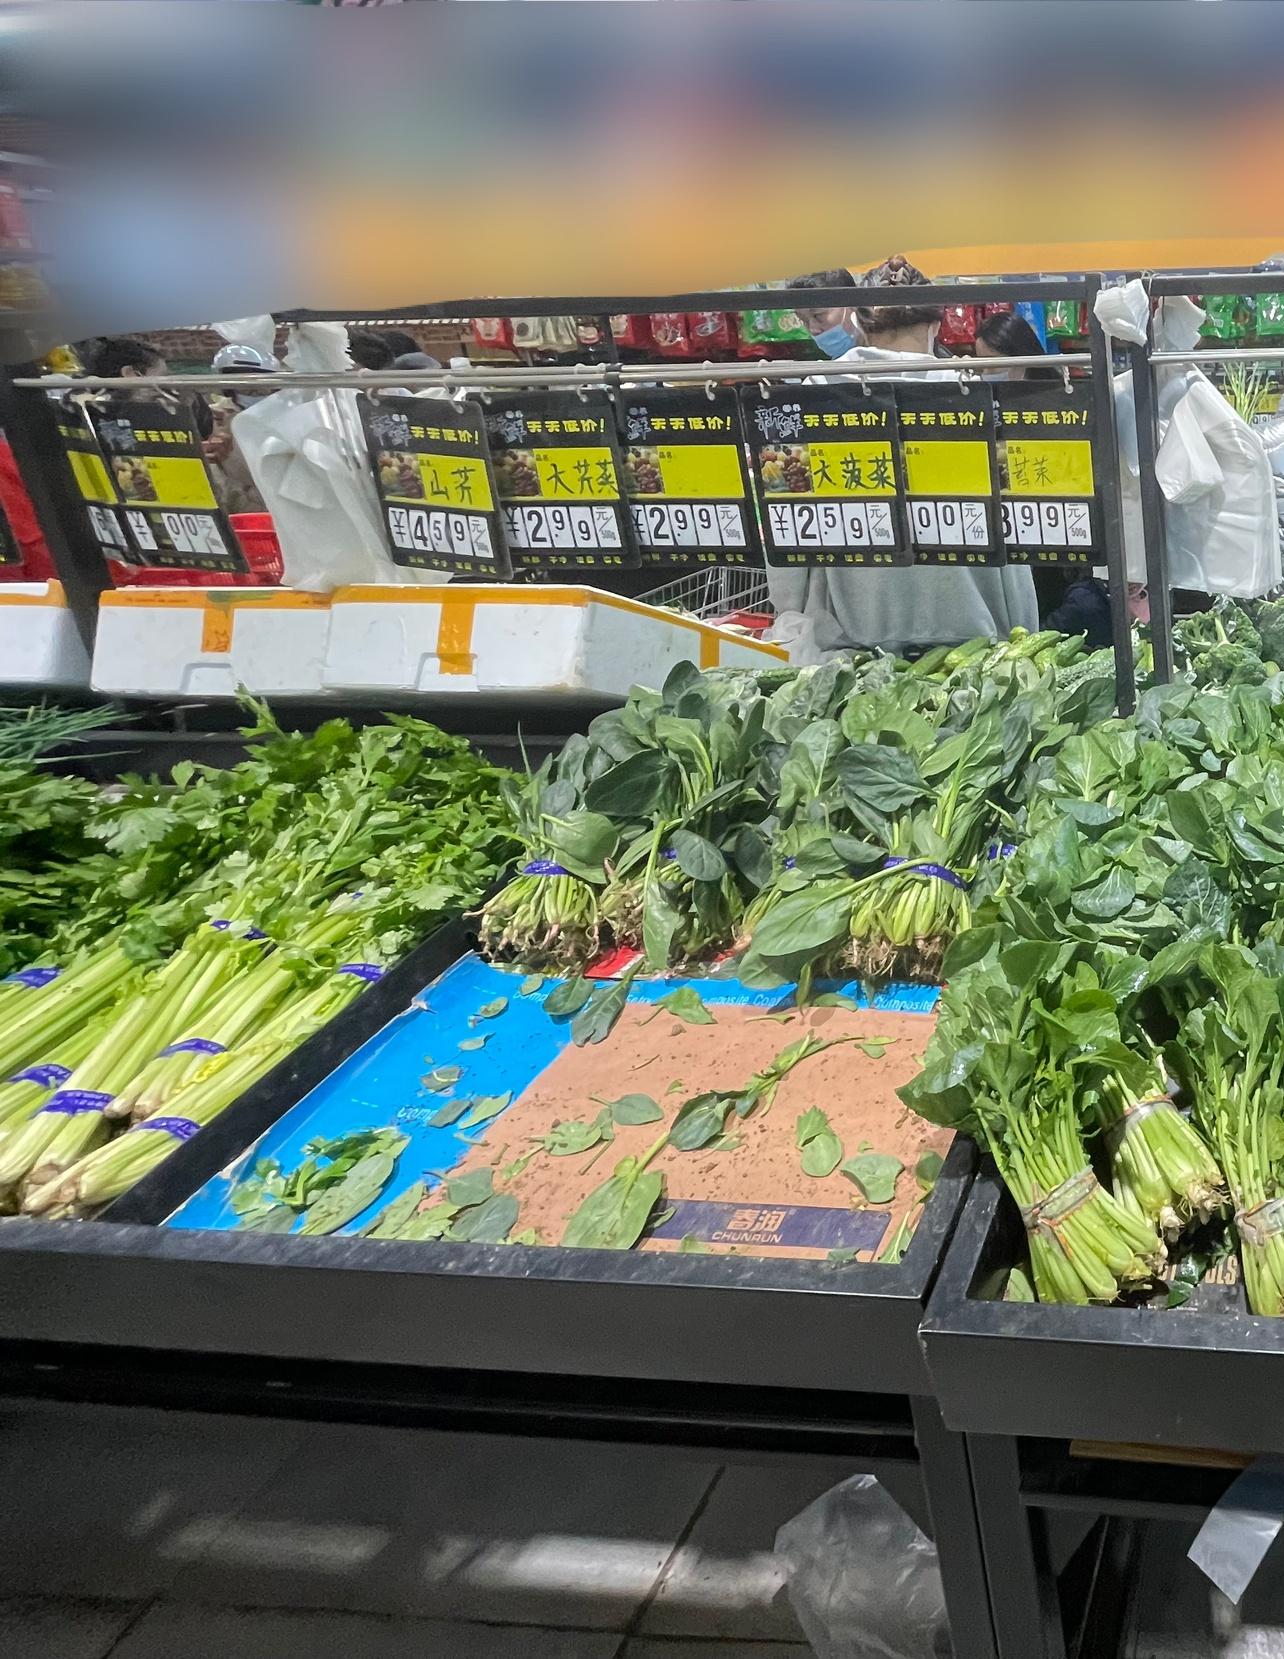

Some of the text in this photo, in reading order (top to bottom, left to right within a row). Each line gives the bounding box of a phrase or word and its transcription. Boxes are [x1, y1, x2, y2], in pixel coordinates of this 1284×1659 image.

[431, 466, 476, 505] 山芹
[547, 459, 619, 496] 大芹菜
[711, 1231, 783, 1243] CHUNRUN
